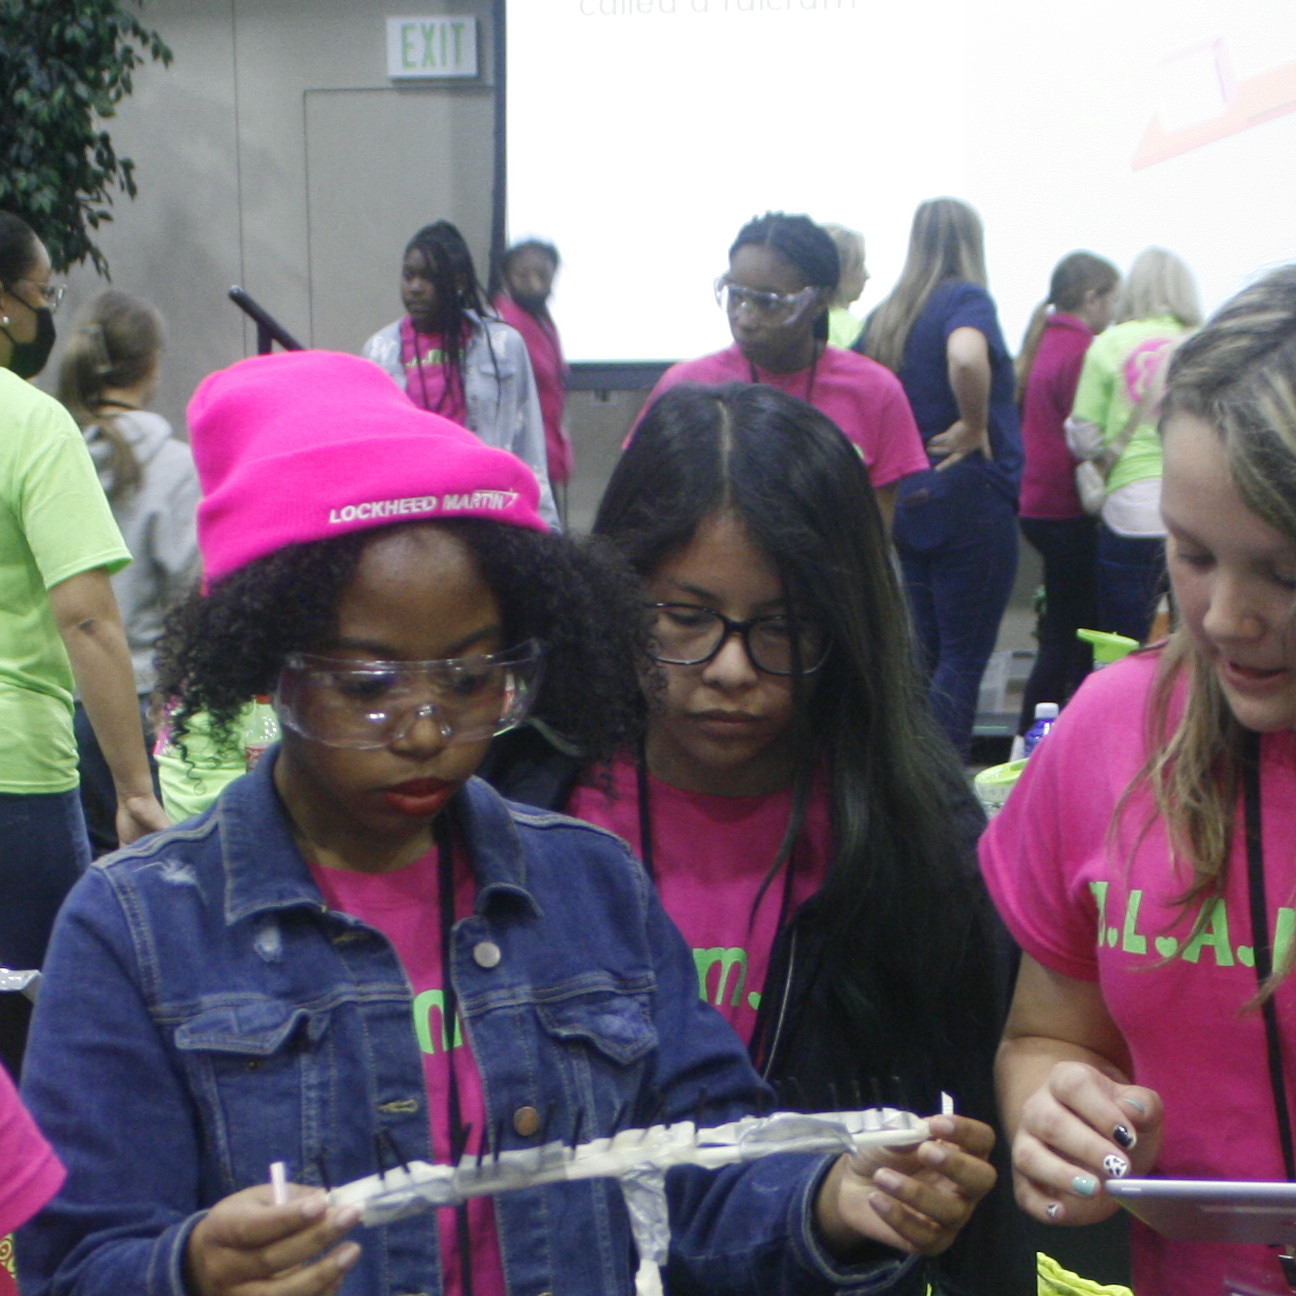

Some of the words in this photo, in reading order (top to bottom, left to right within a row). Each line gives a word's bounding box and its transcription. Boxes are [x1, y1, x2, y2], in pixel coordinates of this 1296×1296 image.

[400, 21, 467, 70] EXIT
[328, 495, 438, 525] LOCKHEED
[442, 492, 505, 511] MARTIN
